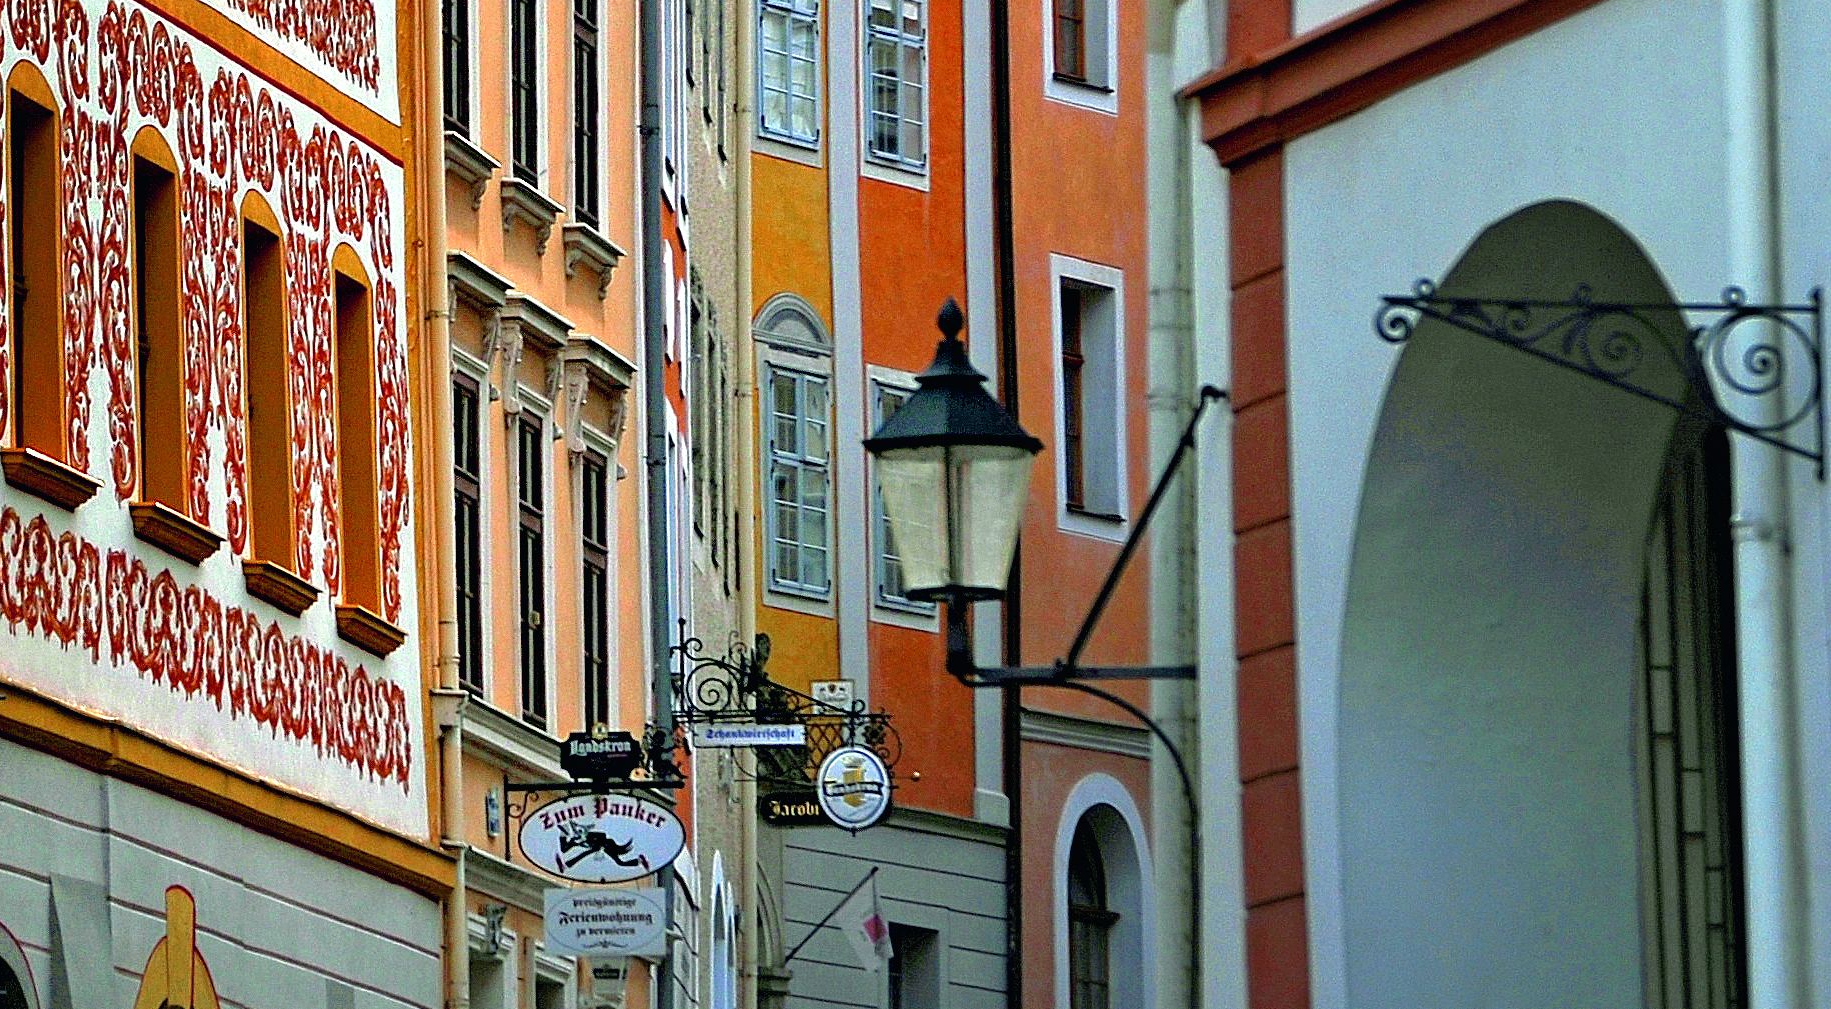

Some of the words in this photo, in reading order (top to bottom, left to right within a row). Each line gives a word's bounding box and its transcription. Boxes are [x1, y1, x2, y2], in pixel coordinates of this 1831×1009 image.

[569, 739, 632, 757] Landskron
[539, 805, 585, 830] Zum
[558, 911, 654, 926] Ferienwohnung
